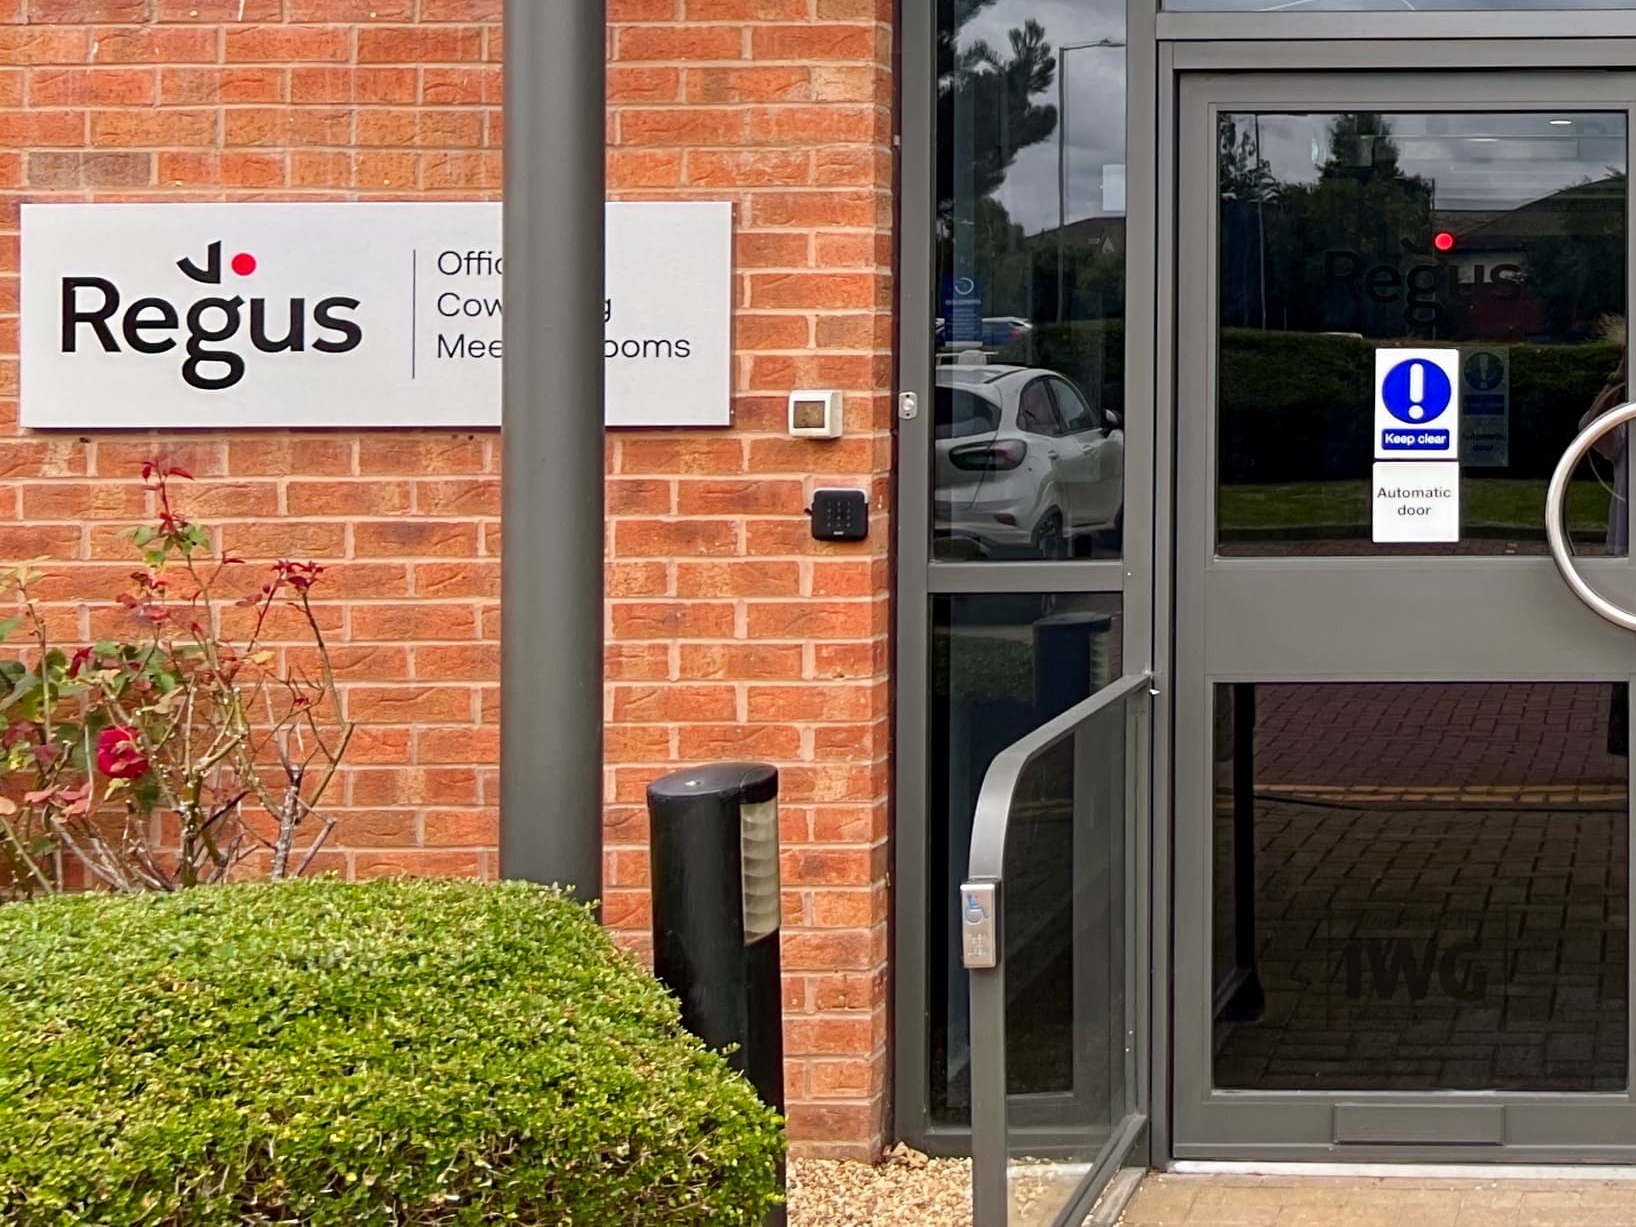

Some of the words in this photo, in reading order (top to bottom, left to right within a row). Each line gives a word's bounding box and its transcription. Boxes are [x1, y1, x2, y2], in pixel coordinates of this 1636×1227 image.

[61, 276, 363, 390] Regus
[604, 339, 691, 358] ooms
[1384, 433, 1415, 446] Keep
[1417, 433, 1447, 444] clear
[1377, 486, 1452, 499] Automatic
[1397, 504, 1432, 516] door
